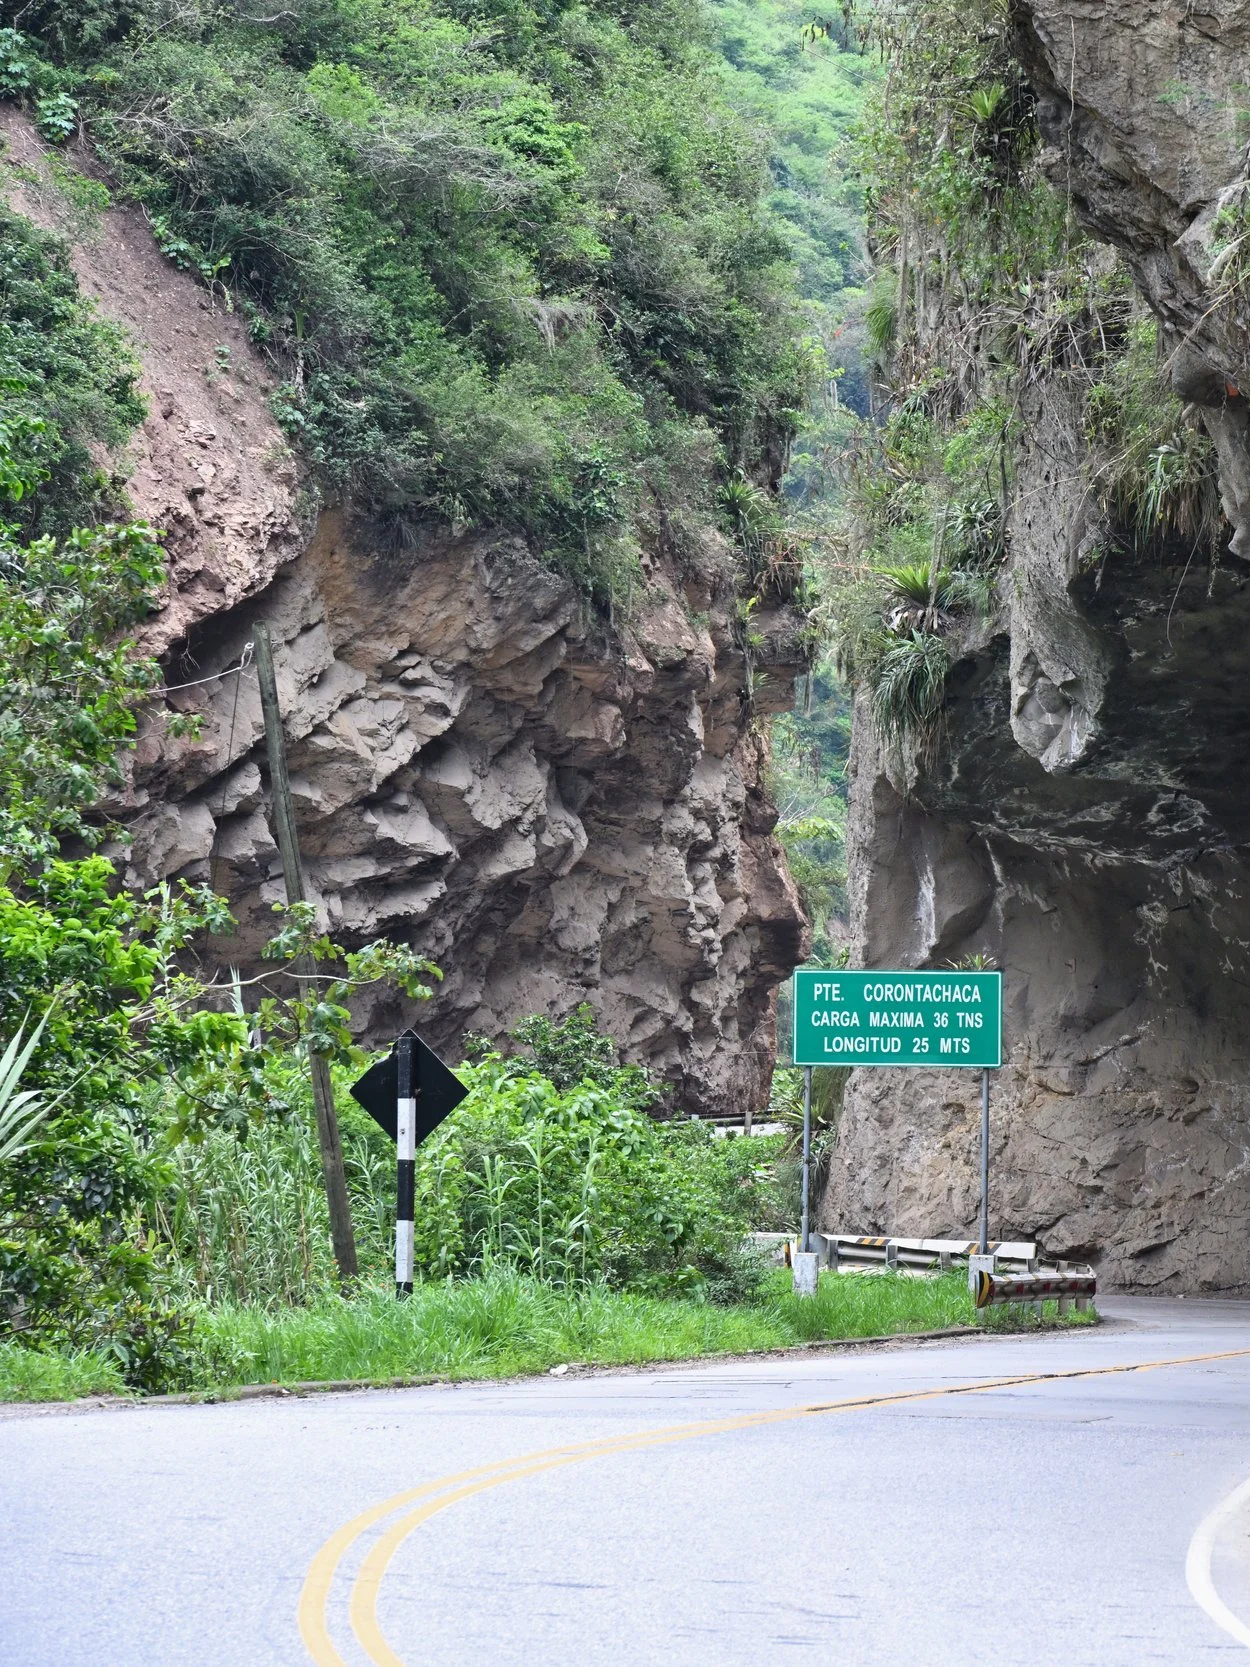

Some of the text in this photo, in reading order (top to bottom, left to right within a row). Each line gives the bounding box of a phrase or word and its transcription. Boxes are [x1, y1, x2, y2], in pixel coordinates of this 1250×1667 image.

[814, 983, 981, 1003] PTE. CORONTACHACA
[811, 1011, 983, 1028] CARGA MAXIMA 36 TNS
[823, 1037, 970, 1054] LONGITUD 25 MTS
